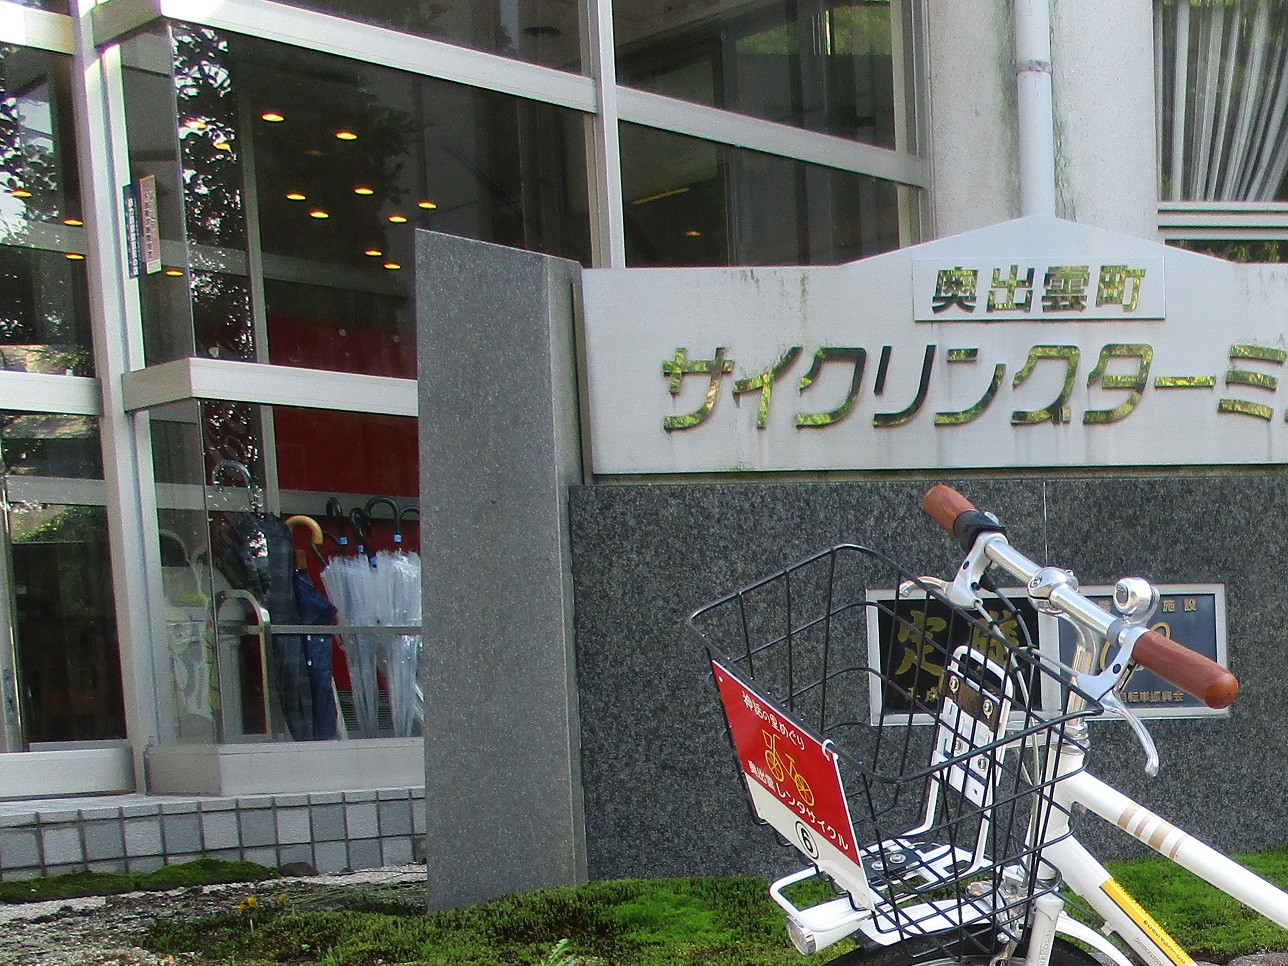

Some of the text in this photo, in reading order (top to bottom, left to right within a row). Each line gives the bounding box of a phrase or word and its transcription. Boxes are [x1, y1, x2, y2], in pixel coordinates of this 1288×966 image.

[932, 264, 1147, 314] 奥出雲町
[742, 690, 805, 751] 神話の里めぐり
[747, 759, 849, 851] 奥出雲レンタサイクル
